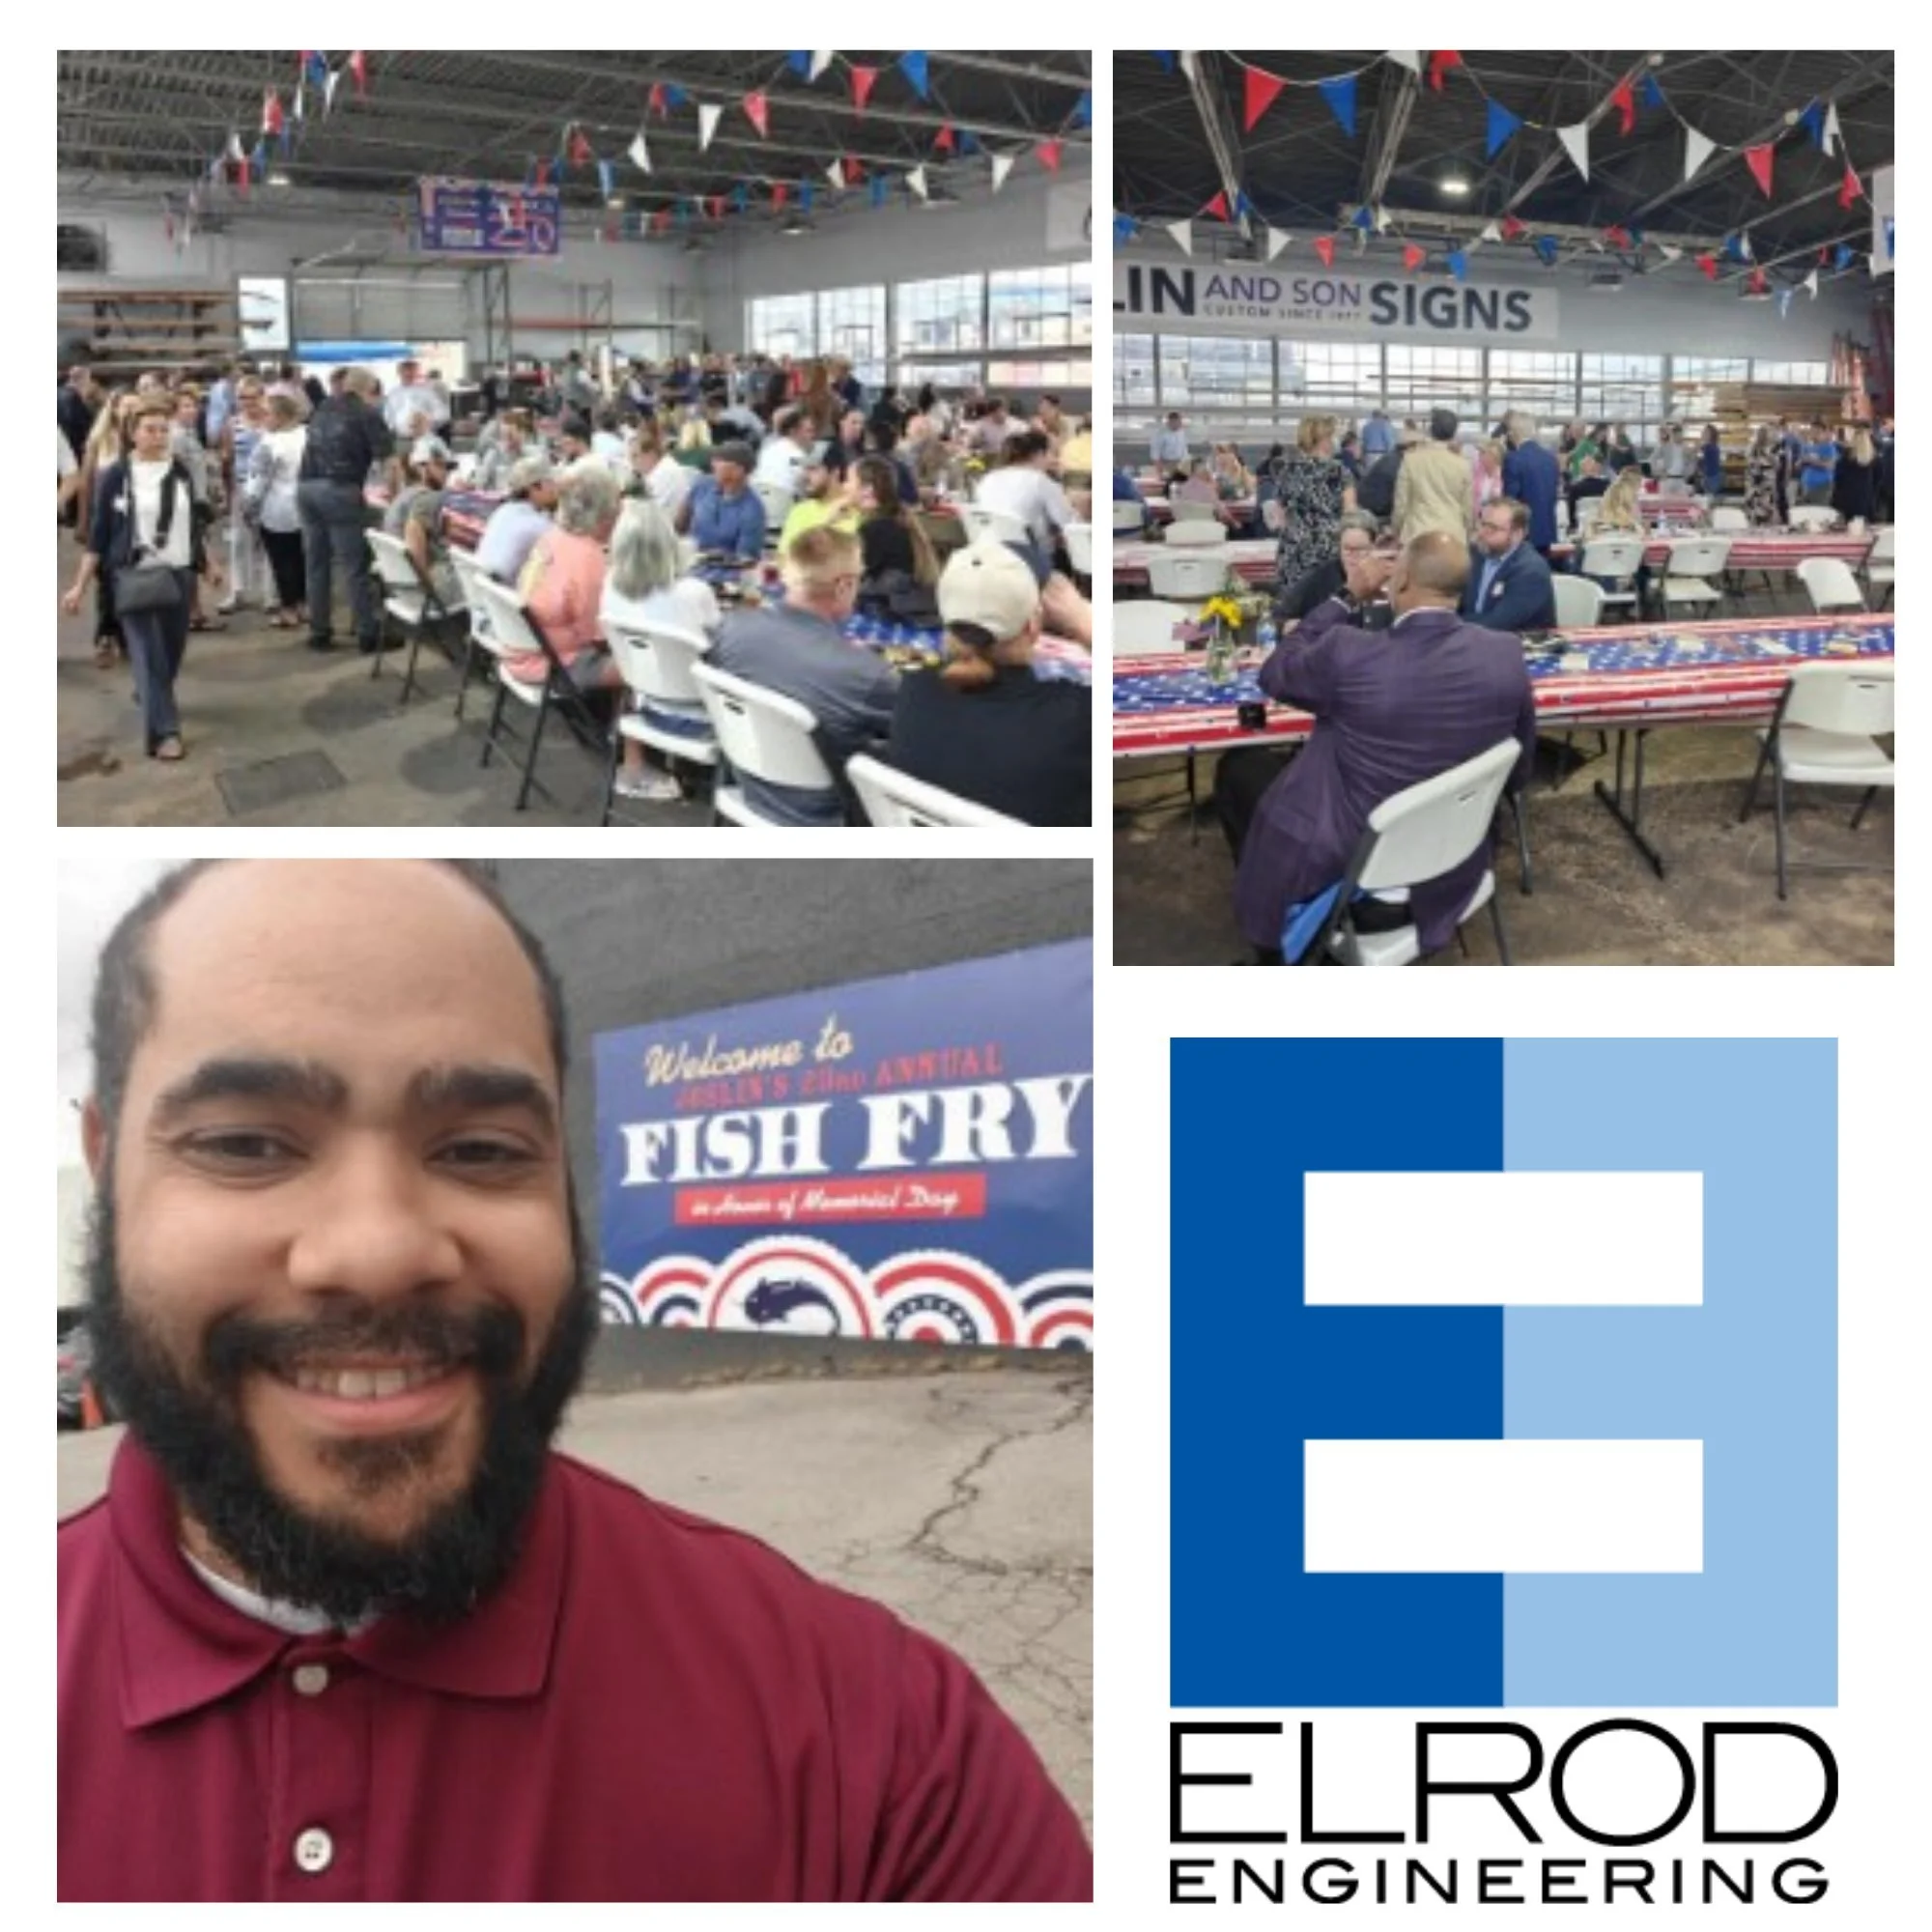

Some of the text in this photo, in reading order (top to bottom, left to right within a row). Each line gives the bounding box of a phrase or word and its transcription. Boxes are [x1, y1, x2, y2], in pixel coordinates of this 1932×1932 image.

[1205, 274, 1282, 302] AND
[1293, 279, 1361, 307] SON
[1370, 281, 1532, 332] SIGNS
[644, 1012, 853, 1088] Welcome to
[876, 1040, 1003, 1093] ANNUAL
[619, 1073, 1094, 1186] FISH FRY
[800, 1184, 903, 1213] Memorial
[901, 1183, 959, 1216] Day
